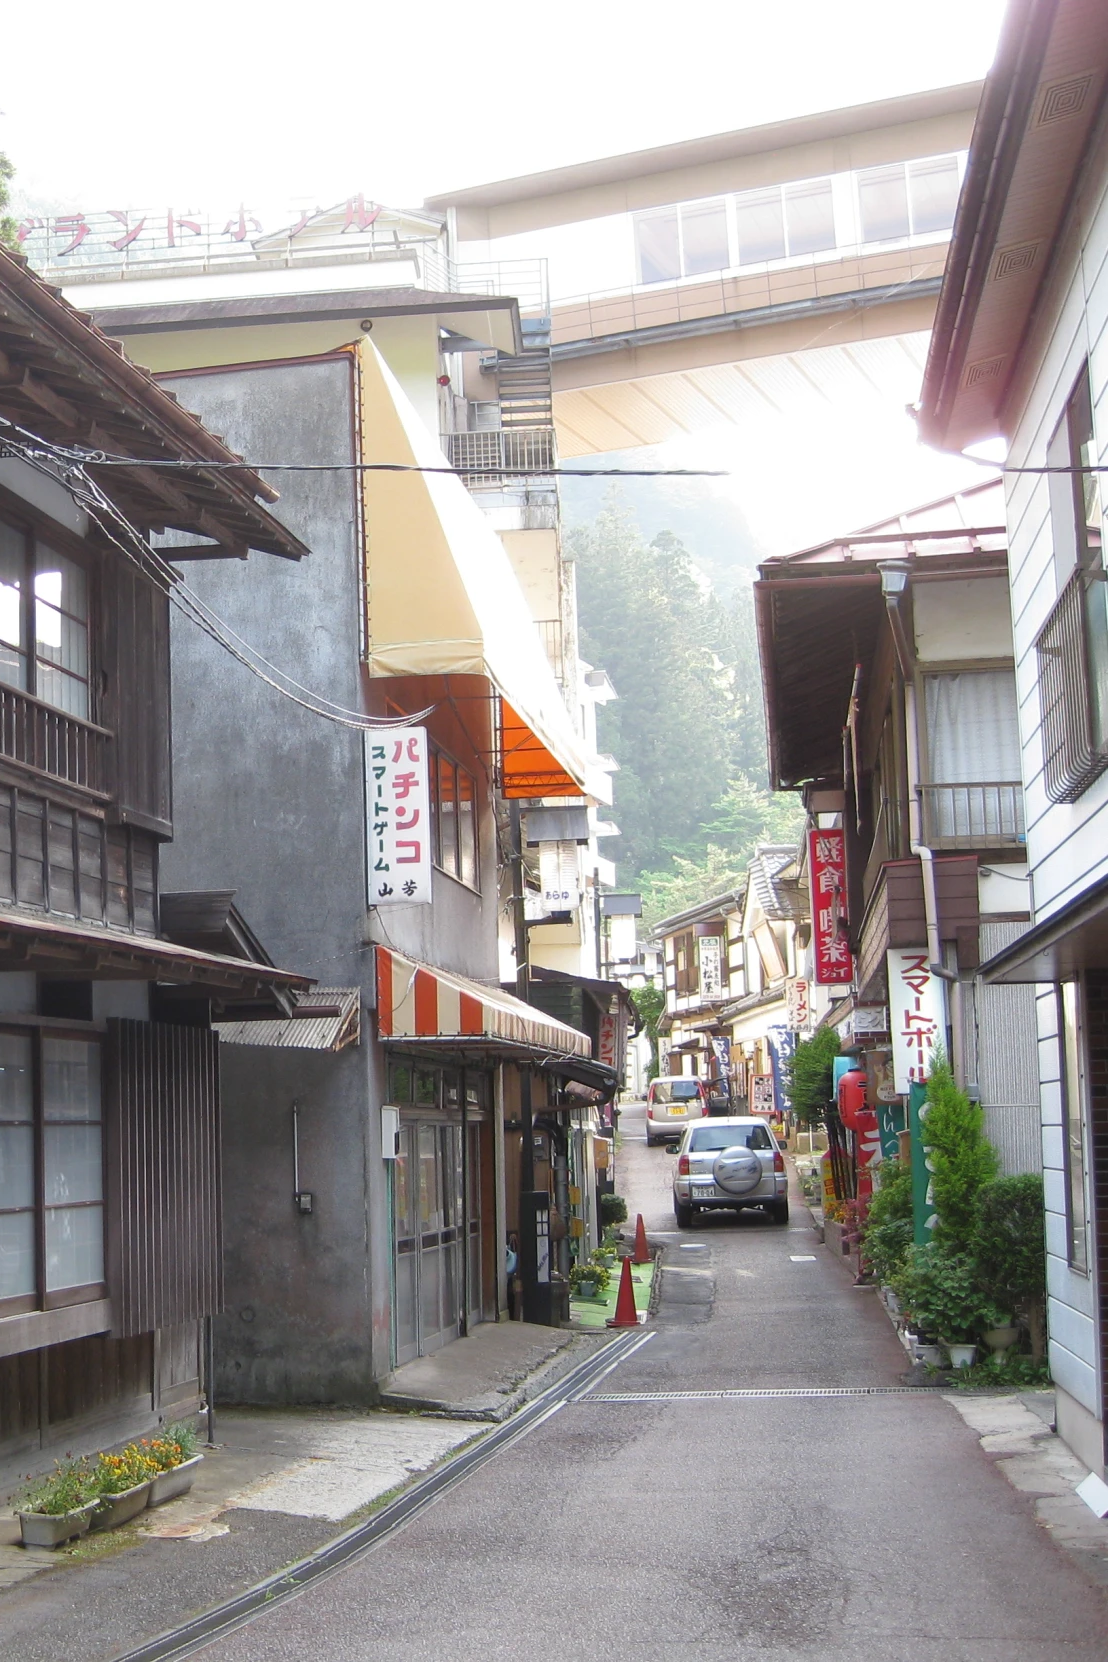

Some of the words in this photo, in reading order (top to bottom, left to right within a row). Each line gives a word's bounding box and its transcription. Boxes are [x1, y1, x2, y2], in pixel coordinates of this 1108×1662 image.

[17, 192, 383, 256] ランドホル
[371, 745, 390, 873] スマートゲーム
[392, 737, 422, 865] パチンコ
[815, 836, 843, 894] 軽食
[795, 982, 808, 1023] ラーメン
[821, 966, 848, 978] ジョイ
[900, 955, 938, 1083] スマートボール
